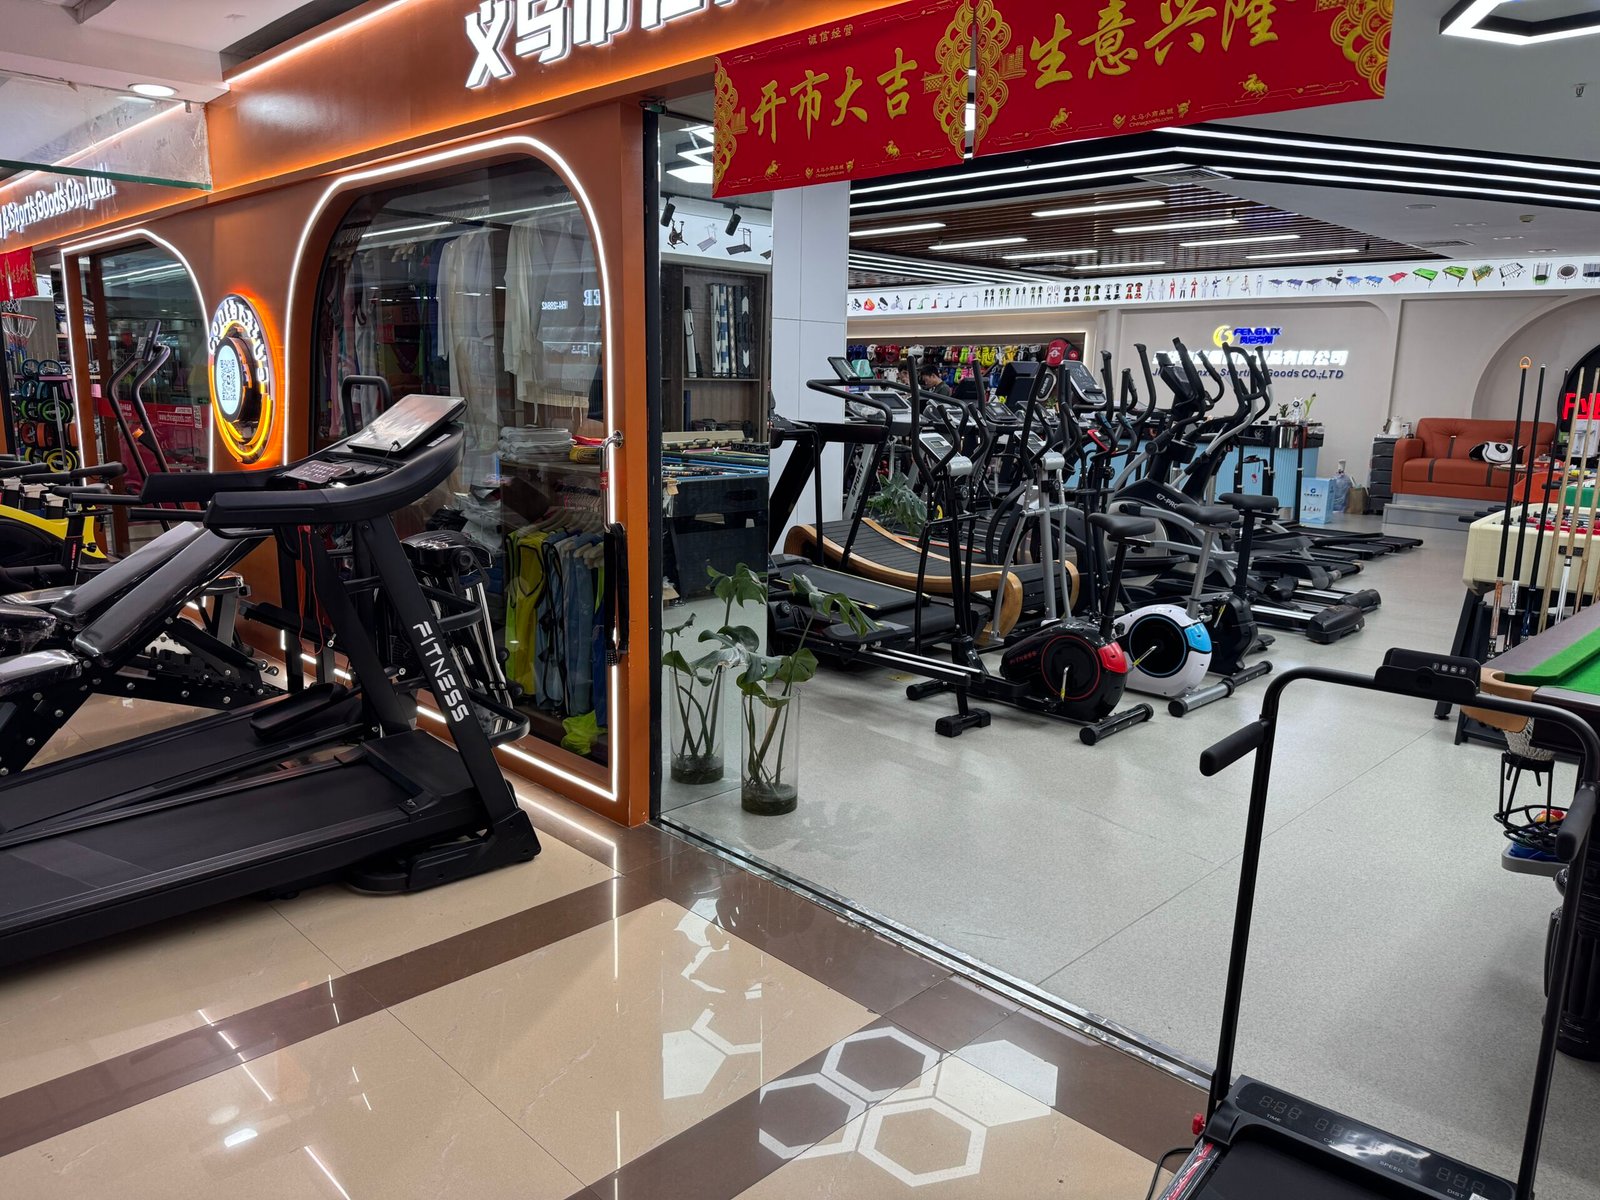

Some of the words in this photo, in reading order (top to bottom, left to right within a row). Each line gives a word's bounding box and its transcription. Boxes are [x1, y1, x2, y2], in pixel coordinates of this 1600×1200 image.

[808, 23, 854, 46] 诚信经营
[1029, 0, 1279, 89] 生意兴隆
[751, 48, 918, 143] 开市大吉
[851, 462, 864, 497] SPORT
[412, 620, 470, 723] FITNESS
[1266, 1113, 1282, 1122] TIME
[1379, 1160, 1404, 1174] SPEED
[1446, 1188, 1465, 1198] DIST
